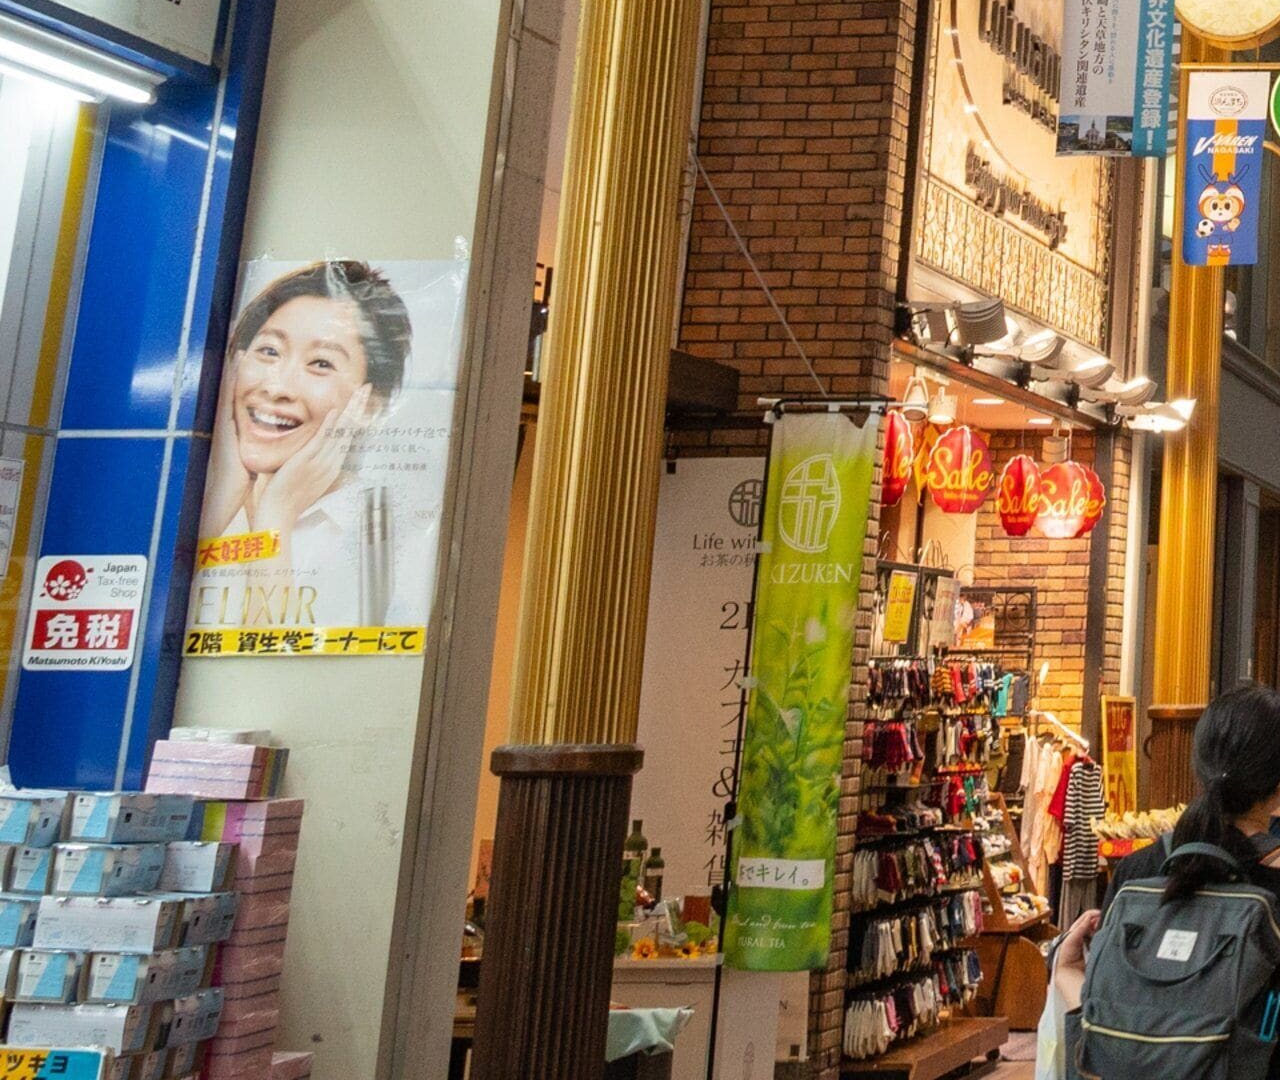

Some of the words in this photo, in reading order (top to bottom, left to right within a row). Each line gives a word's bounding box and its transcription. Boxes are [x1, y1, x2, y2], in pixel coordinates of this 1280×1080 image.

[928, 447, 993, 493] Sale
[996, 473, 1040, 515] Sale
[1037, 478, 1087, 518] Sale
[692, 533, 726, 551] Life
[97, 575, 139, 586] Tax-free
[110, 587, 137, 599] Shop
[193, 584, 320, 625] ELIXIR
[44, 613, 121, 649] 免税
[186, 631, 223, 654] 2階
[27, 656, 87, 666] Matsumoto
[88, 656, 128, 666] KiYoshi
